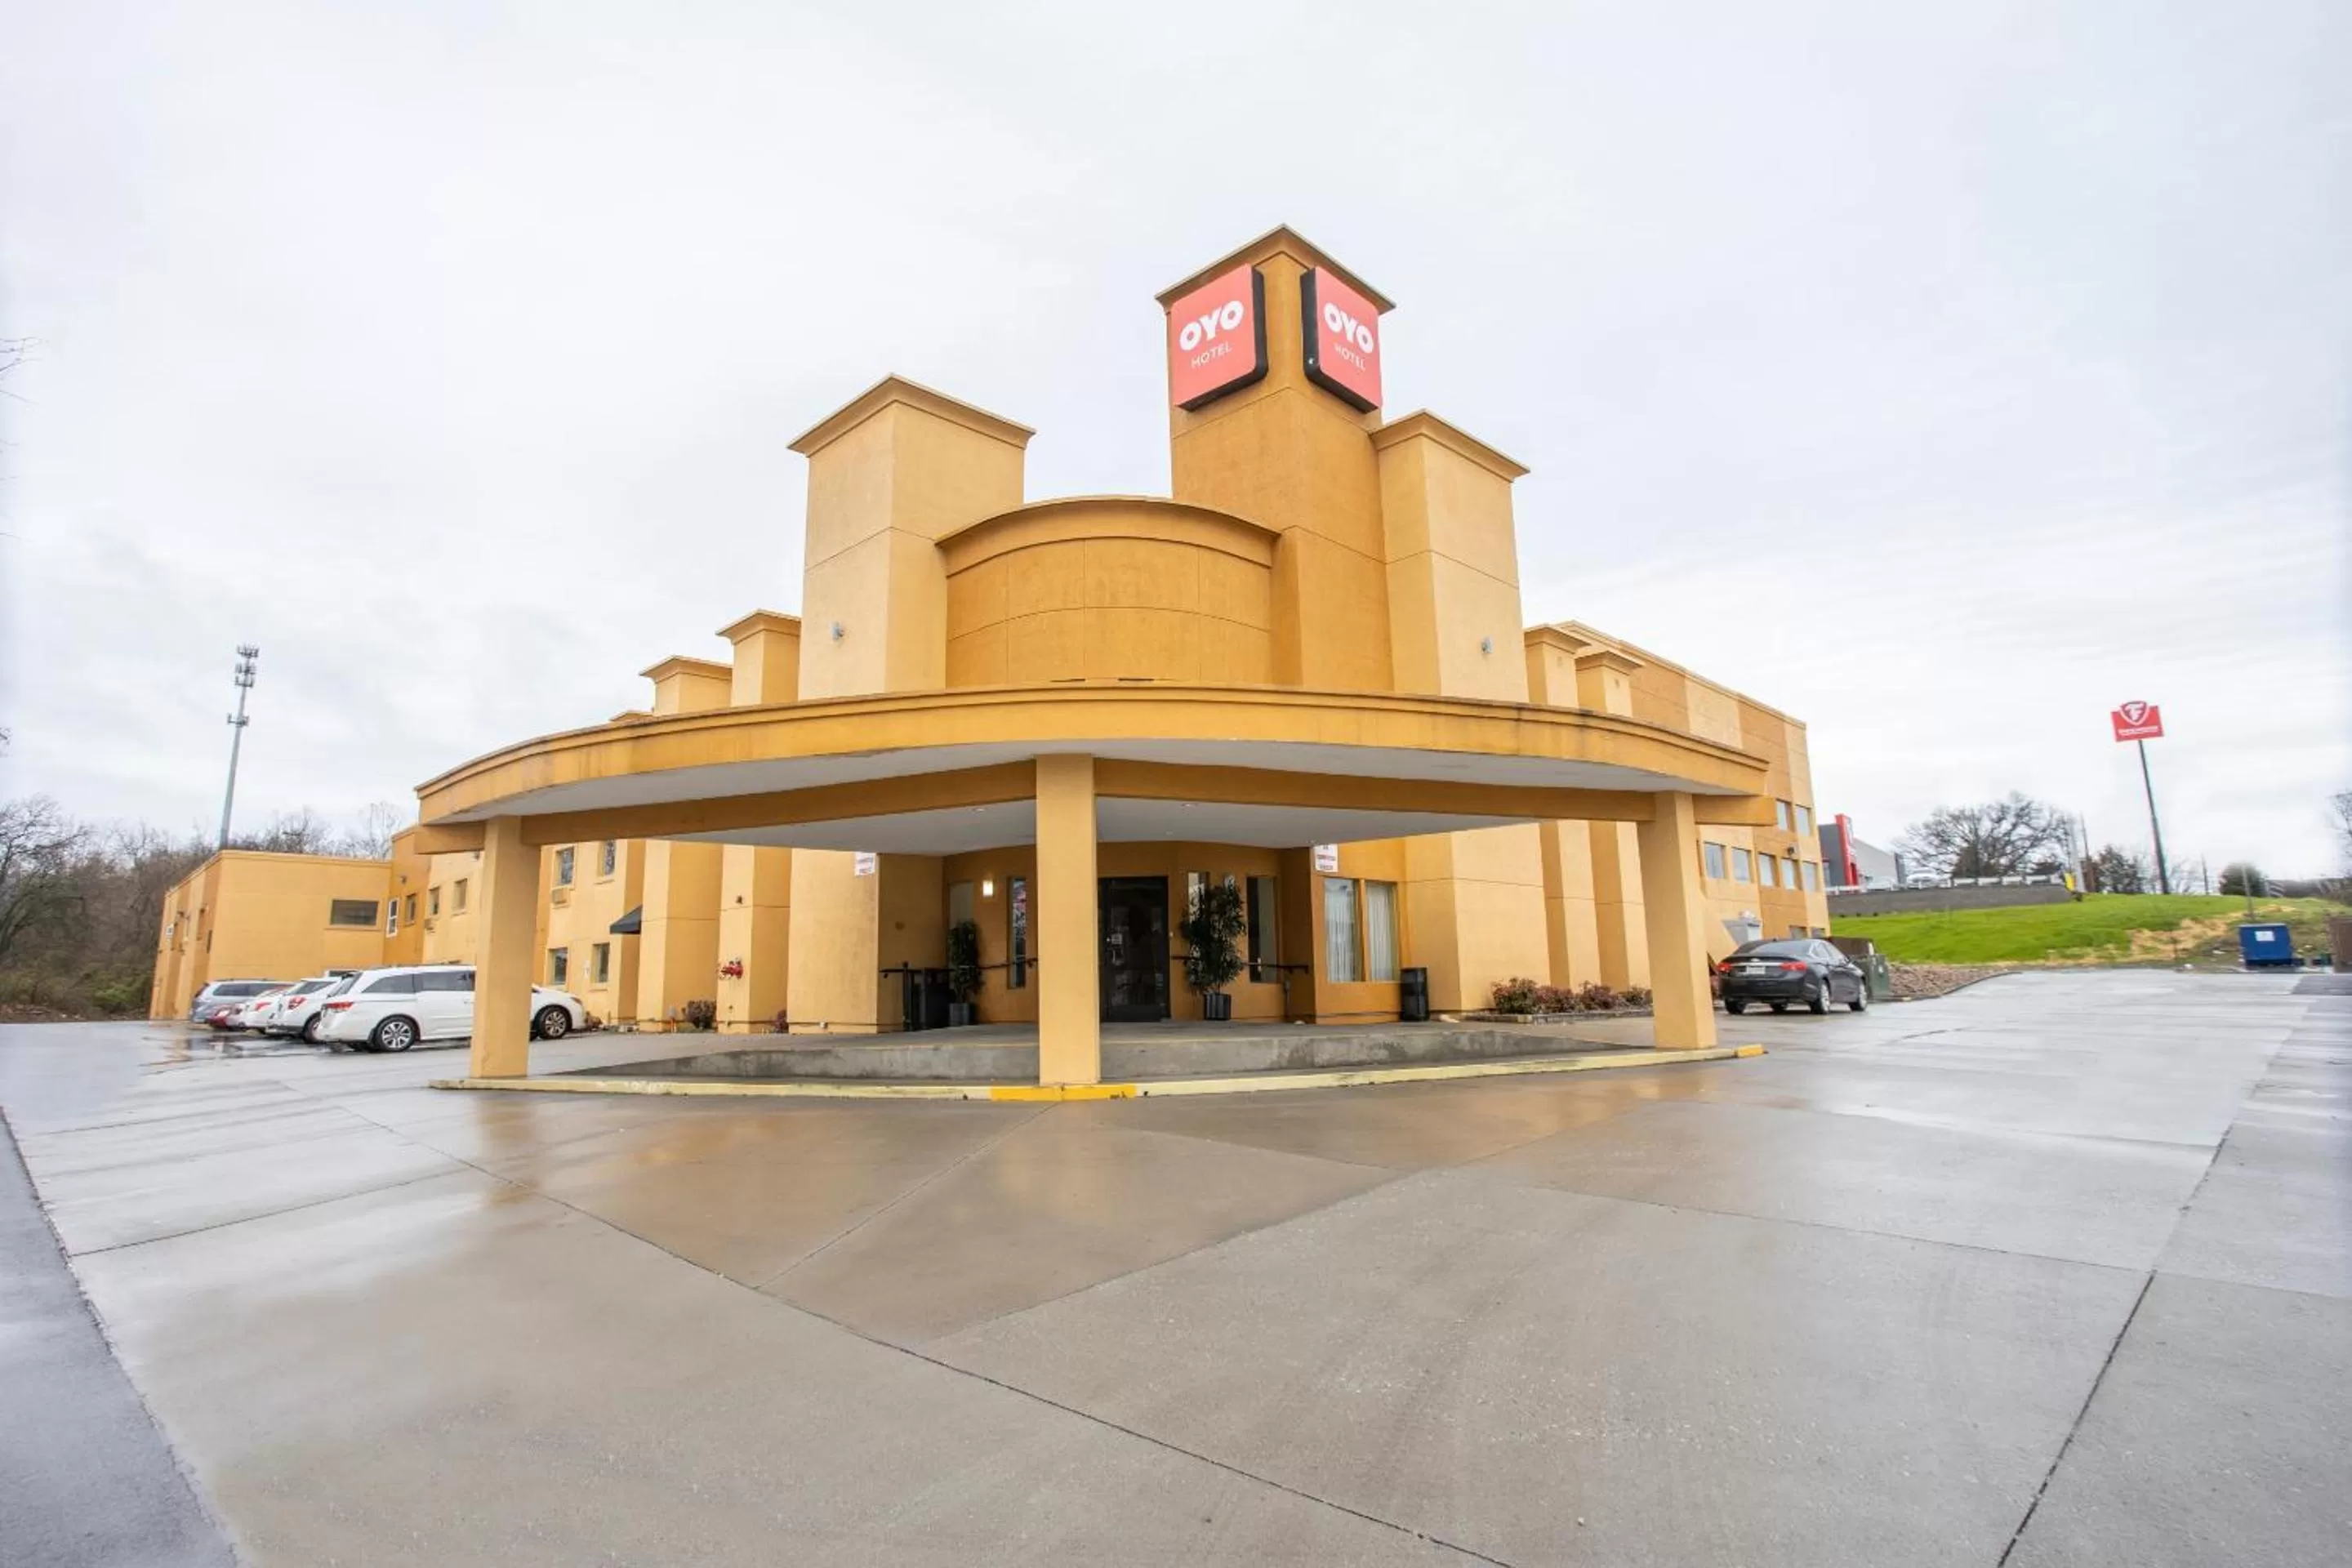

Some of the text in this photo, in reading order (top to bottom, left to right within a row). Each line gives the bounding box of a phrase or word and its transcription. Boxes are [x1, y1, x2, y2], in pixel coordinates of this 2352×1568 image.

[1179, 301, 1244, 350] OYO
[1324, 302, 1374, 354] OYO
[1191, 341, 1232, 369] HOTEL
[1334, 343, 1366, 372] HOTEL
